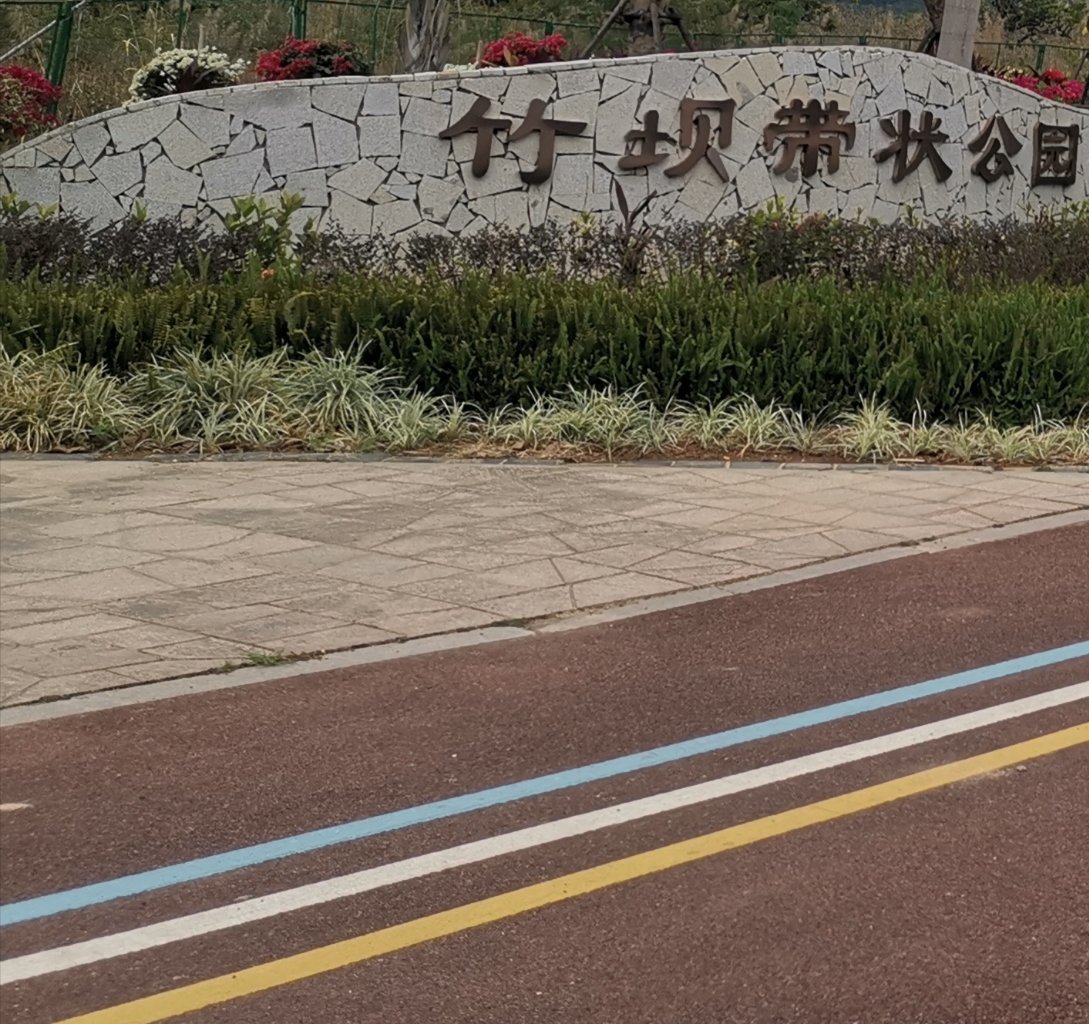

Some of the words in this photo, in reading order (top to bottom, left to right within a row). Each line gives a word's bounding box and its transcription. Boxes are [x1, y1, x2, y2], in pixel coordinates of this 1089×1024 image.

[439, 96, 1079, 187] 竹坝带状公园
